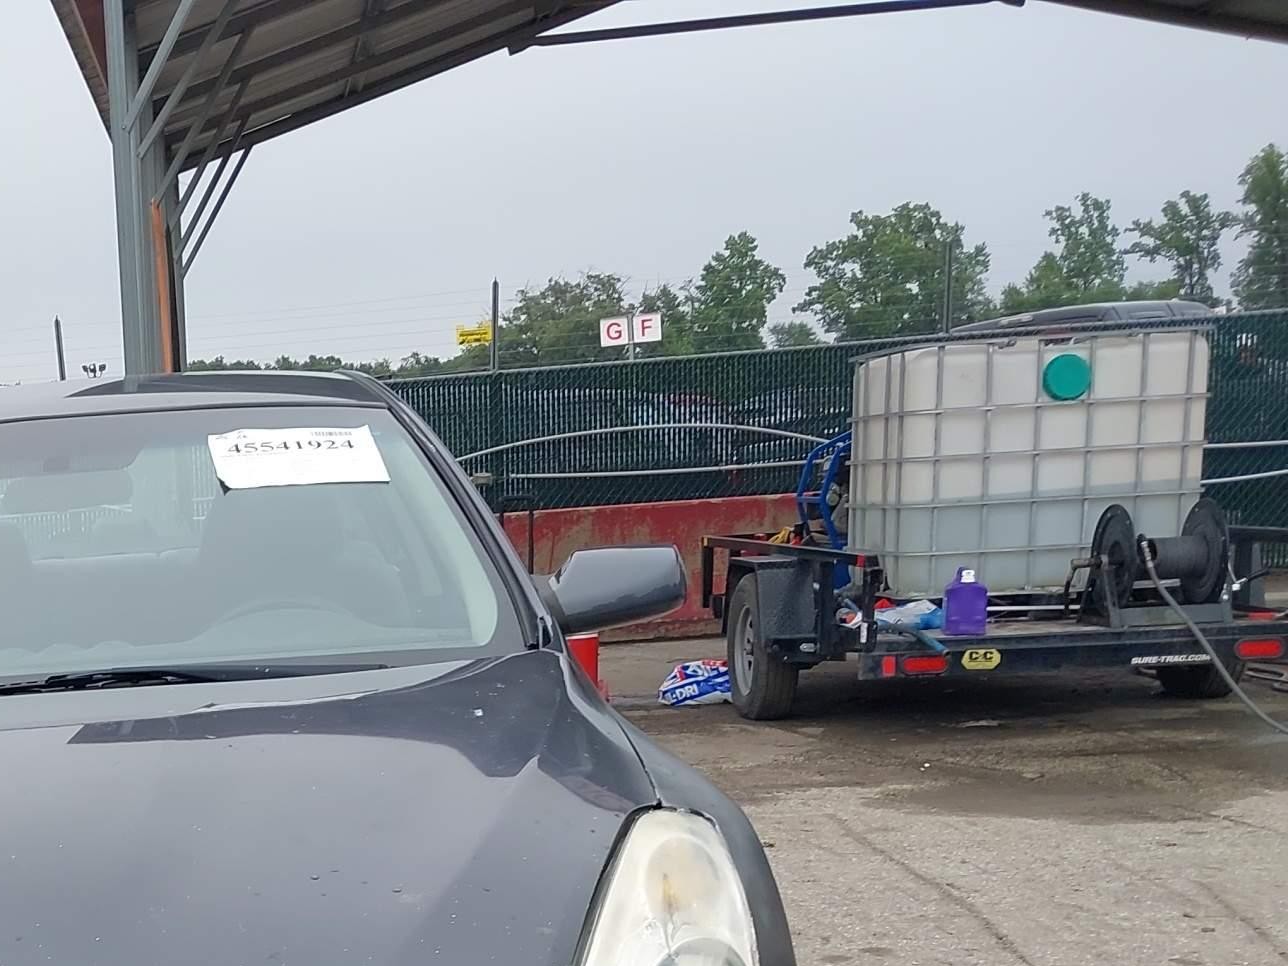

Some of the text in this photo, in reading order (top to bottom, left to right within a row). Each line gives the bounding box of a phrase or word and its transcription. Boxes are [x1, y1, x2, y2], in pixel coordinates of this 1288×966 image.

[606, 323, 622, 340] G
[641, 319, 653, 337] F
[228, 439, 354, 453] 45541924
